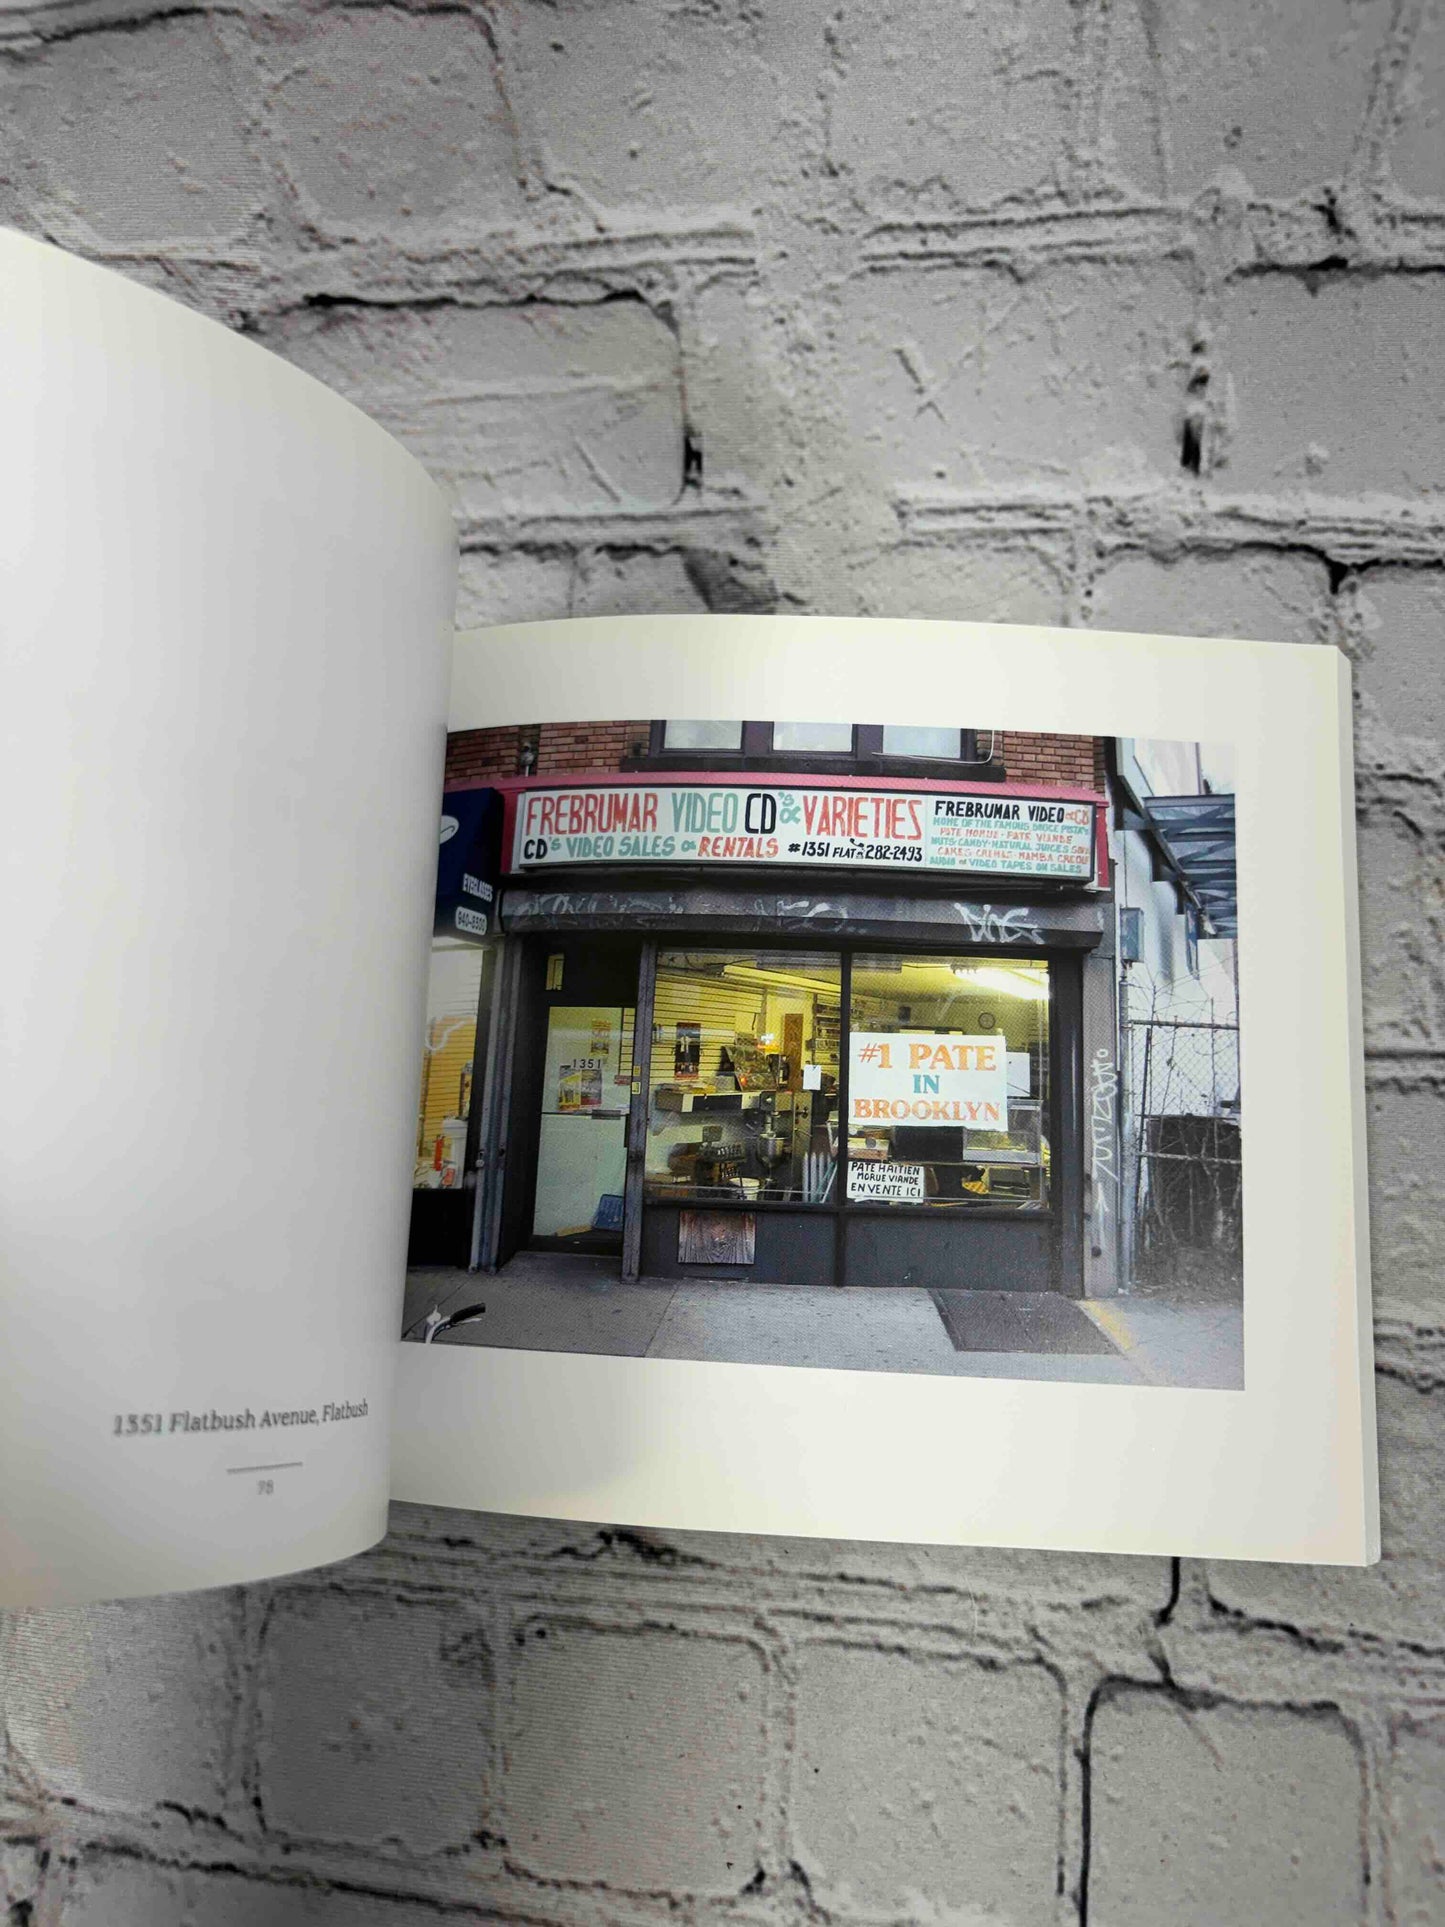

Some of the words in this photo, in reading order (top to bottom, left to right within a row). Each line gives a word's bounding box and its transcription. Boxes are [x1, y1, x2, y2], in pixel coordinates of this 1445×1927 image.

[526, 793, 658, 835] FREBRUMAR
[672, 793, 738, 833] VIDEO
[803, 795, 922, 840] VARIETIES
[934, 800, 1020, 820] FREBRUMAR
[1028, 805, 1065, 823] VIDEO
[961, 818, 973, 828] OF
[975, 819, 992, 829] THE
[566, 837, 613, 858] VIDEO
[618, 836, 676, 857] SALES
[698, 837, 779, 859] RENTALS
[788, 841, 831, 858] #1351
[865, 844, 923, 862] 282-2493
[1035, 843, 1069, 853] JUICES
[969, 859, 998, 868] VIDEO
[1001, 860, 1033, 870] TAPES
[1050, 863, 1082, 873] SALES
[573, 1059, 601, 1069] 1351
[858, 1043, 893, 1069] #1
[909, 1043, 997, 1072] PATE
[913, 1074, 940, 1094] IN
[853, 1098, 1000, 1121] BROOKLYN
[851, 1161, 876, 1173] PATE
[879, 1165, 920, 1176] HAITIEN
[857, 1172, 887, 1183] MORUE
[889, 1174, 919, 1185] VIANDE
[851, 1182, 866, 1192] EN
[867, 1184, 902, 1196] VENTE
[906, 1187, 921, 1197] ICI
[168, 1408, 256, 1433] Flatbush
[259, 1407, 320, 1427] Avenue,
[322, 1398, 368, 1423] Flatbush
